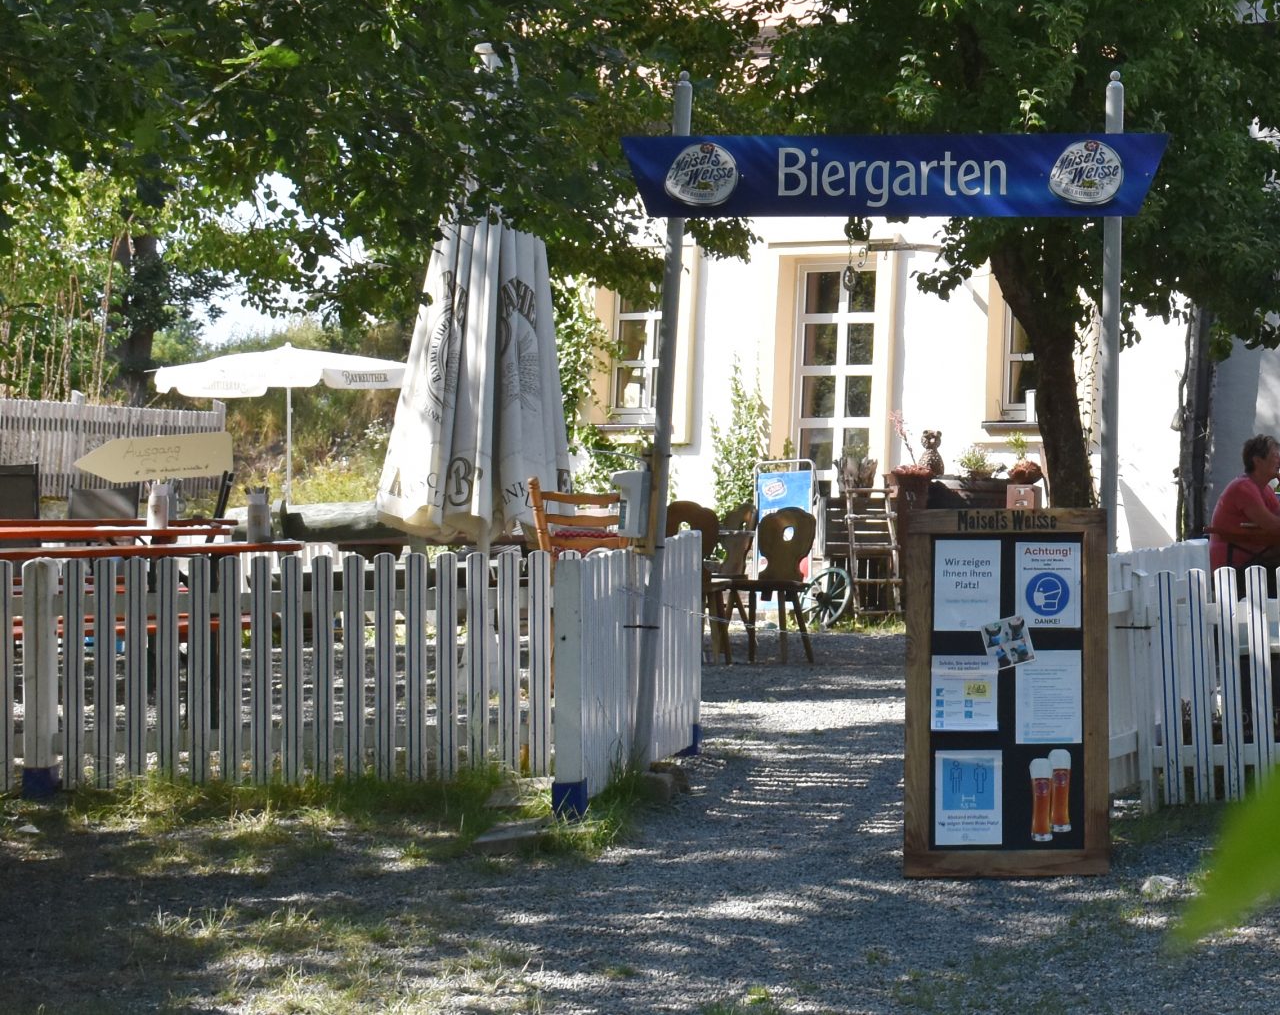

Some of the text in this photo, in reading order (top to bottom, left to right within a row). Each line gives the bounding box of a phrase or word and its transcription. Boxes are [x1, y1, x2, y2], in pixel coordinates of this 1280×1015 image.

[669, 149, 721, 180] Maisel's
[1051, 148, 1106, 179] Maisel's
[684, 167, 734, 185] Weisse
[777, 147, 1007, 208] Biergarten
[1068, 165, 1119, 184] Weisse
[342, 370, 388, 384] BAYREUTHER
[957, 510, 1057, 531] Maisel's Weisse
[1024, 547, 1072, 557] Achtung!
[945, 558, 991, 569] Wir zeigen
[943, 570, 992, 578] Ihnen Ihren
[955, 581, 980, 590] Platz!
